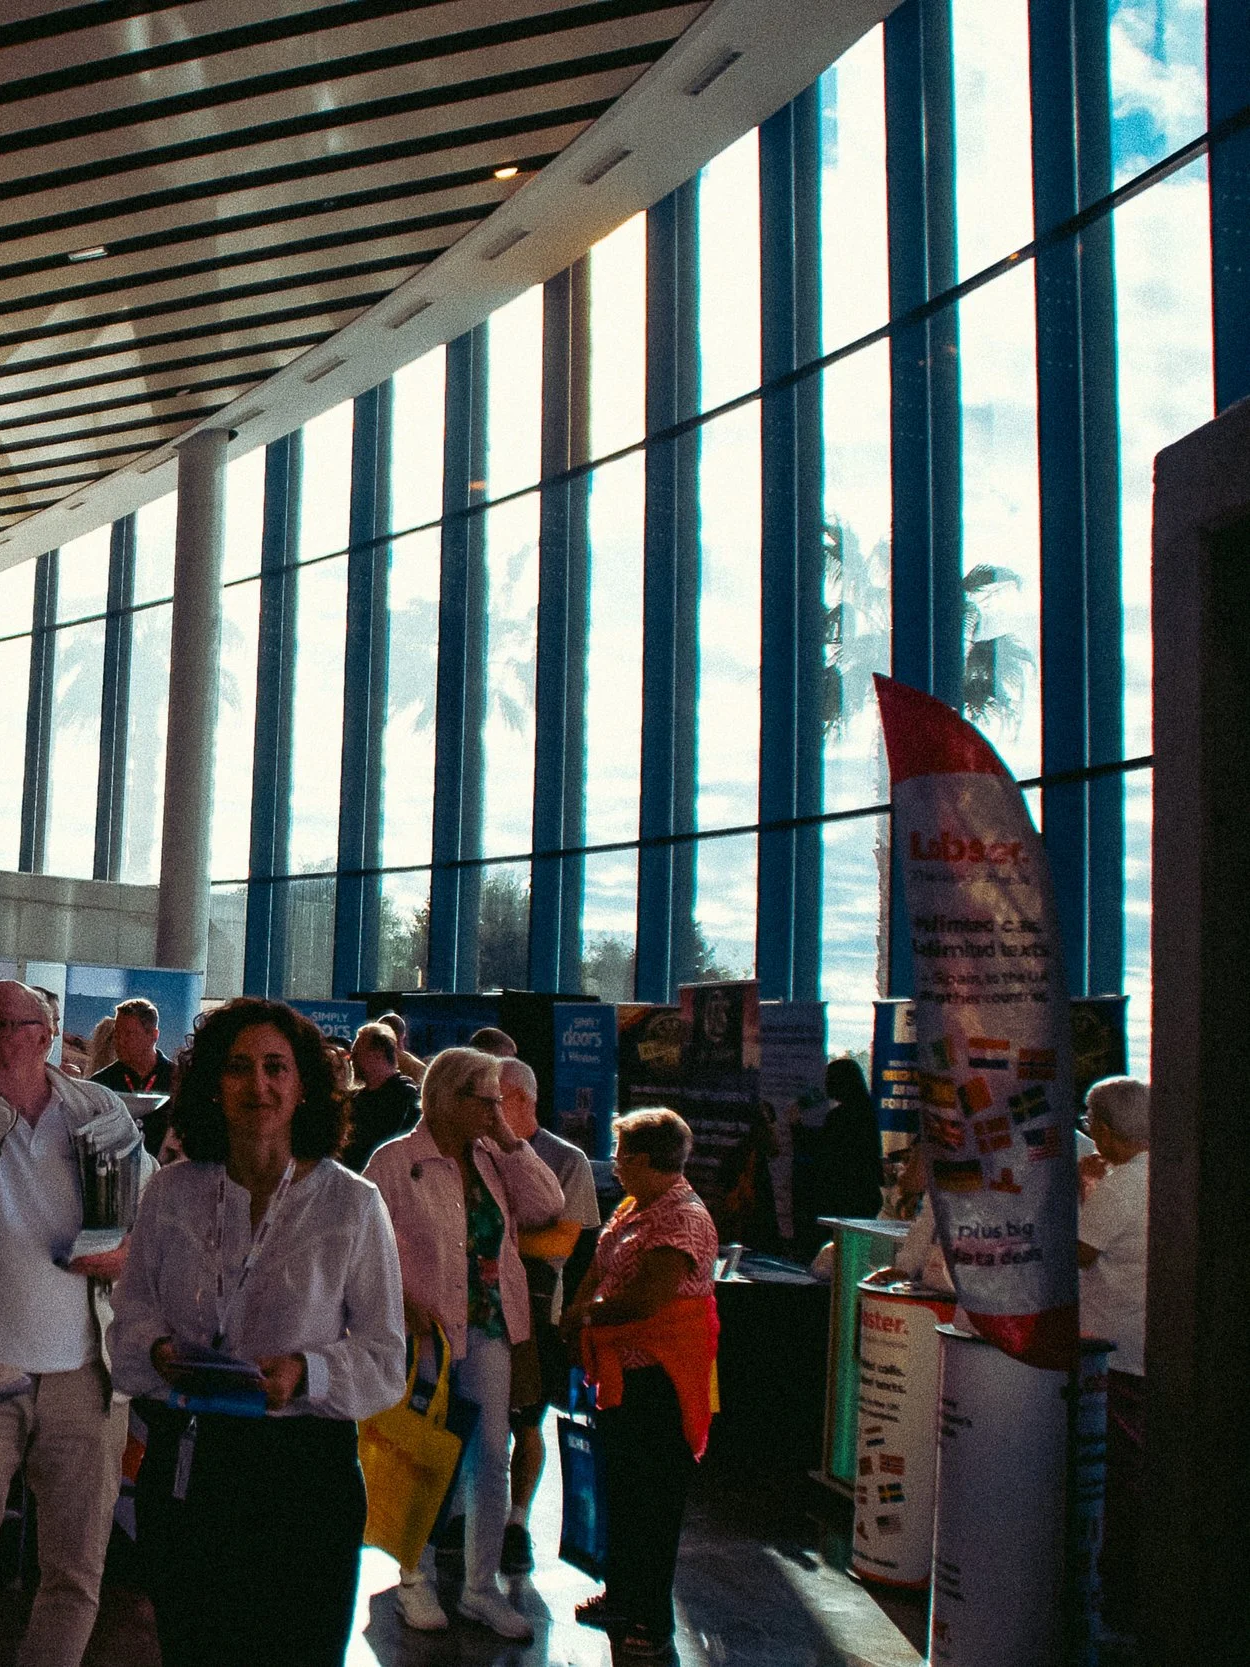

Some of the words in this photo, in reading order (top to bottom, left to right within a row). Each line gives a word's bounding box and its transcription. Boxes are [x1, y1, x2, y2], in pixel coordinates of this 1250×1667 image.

[322, 1023, 351, 1040] ors
[562, 1024, 603, 1048] doors
[861, 1310, 910, 1335] ster.
